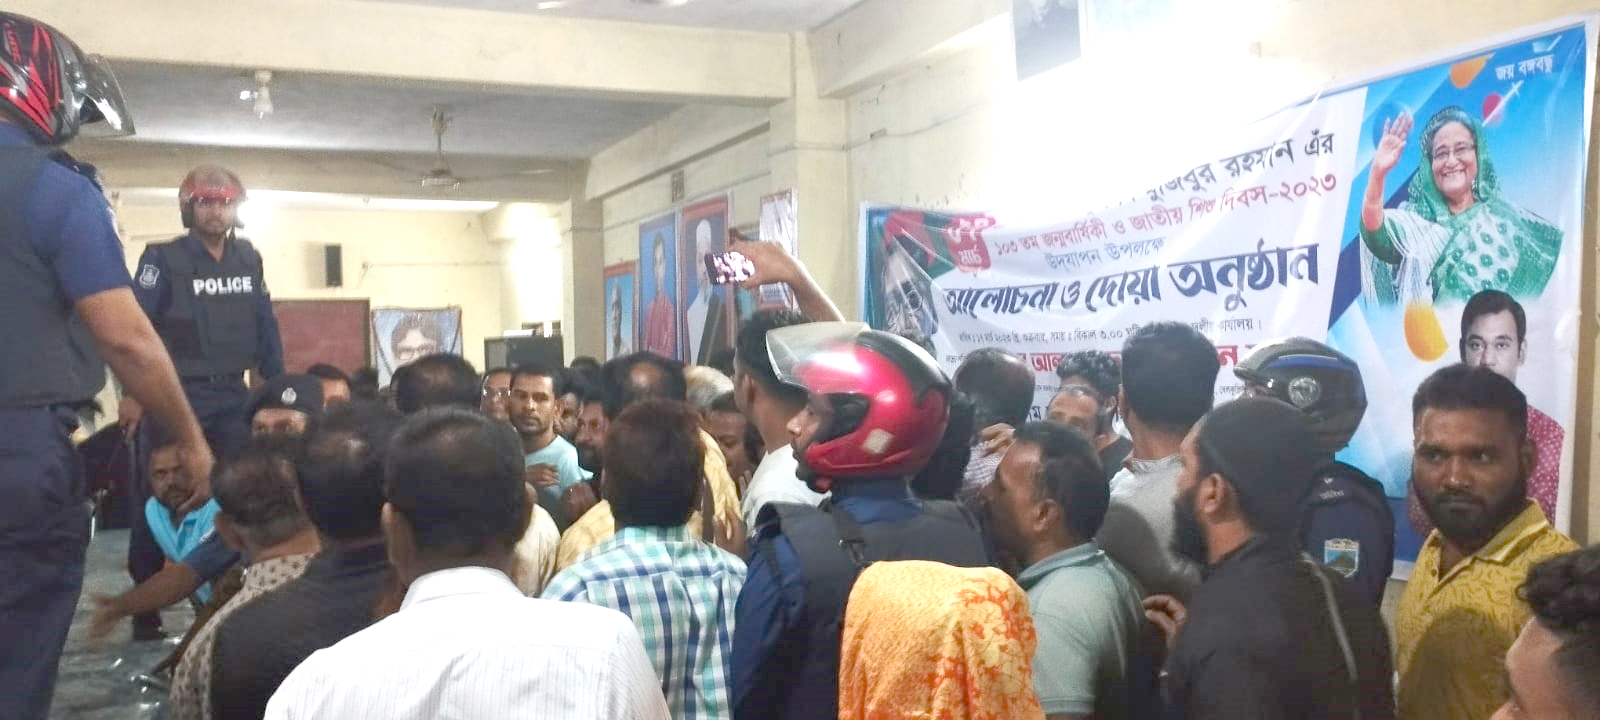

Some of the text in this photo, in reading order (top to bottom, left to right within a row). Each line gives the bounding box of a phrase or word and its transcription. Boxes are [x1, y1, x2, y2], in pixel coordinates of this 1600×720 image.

[1219, 139, 1294, 178] রহমান
[1304, 129, 1335, 157] এঁর
[1019, 235, 1039, 249] তম
[1112, 218, 1126, 234] ও
[1129, 203, 1183, 233] জাতীয়
[192, 276, 253, 296] POLICE
[942, 237, 1320, 319] আলোচনা ও দোয়া অনুষ্ঠান
